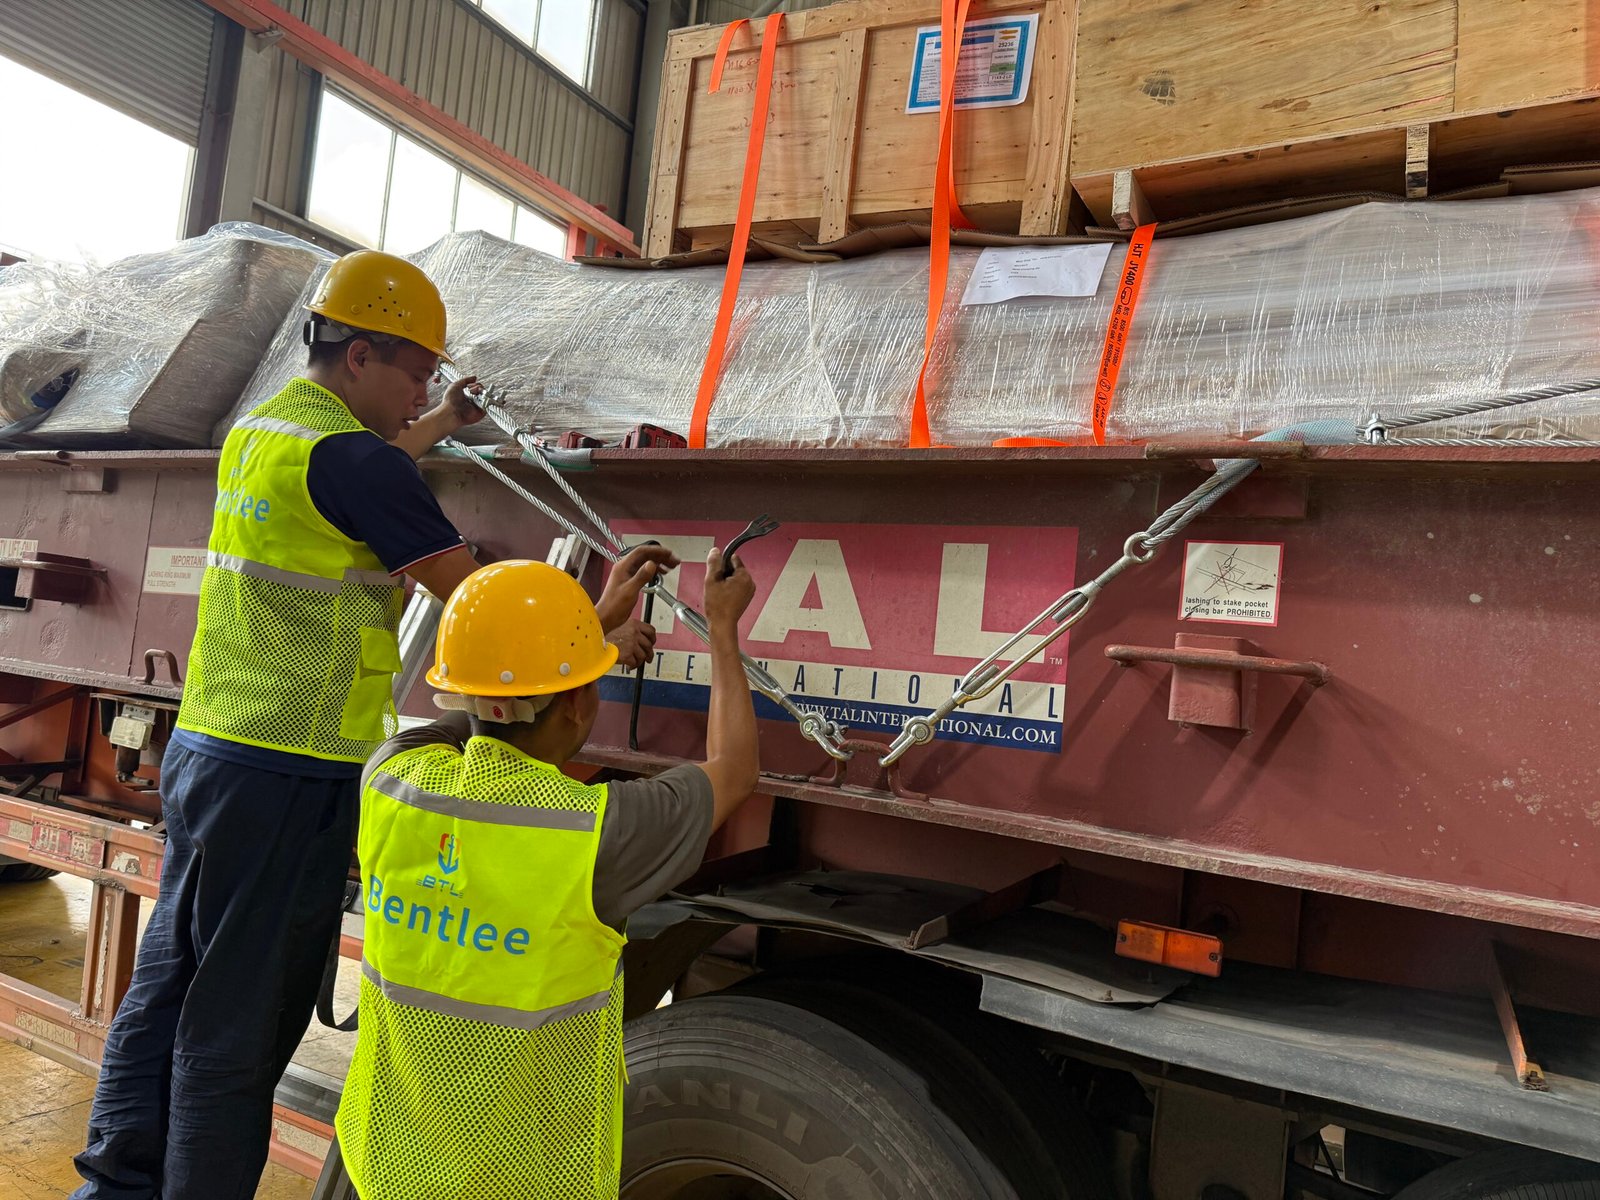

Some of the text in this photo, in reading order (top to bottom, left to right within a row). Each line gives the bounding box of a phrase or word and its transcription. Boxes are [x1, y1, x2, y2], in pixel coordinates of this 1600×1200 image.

[1124, 243, 1145, 286] HJT JY400
[1184, 606, 1210, 615] closing
[1212, 607, 1224, 615] bar
[1185, 596, 1210, 606] lashing
[1223, 598, 1242, 606] stake
[1244, 600, 1269, 609] pocket
[422, 874, 459, 897] BTL
[367, 874, 530, 955] Bentlee
[631, 1078, 809, 1146] ANLI
